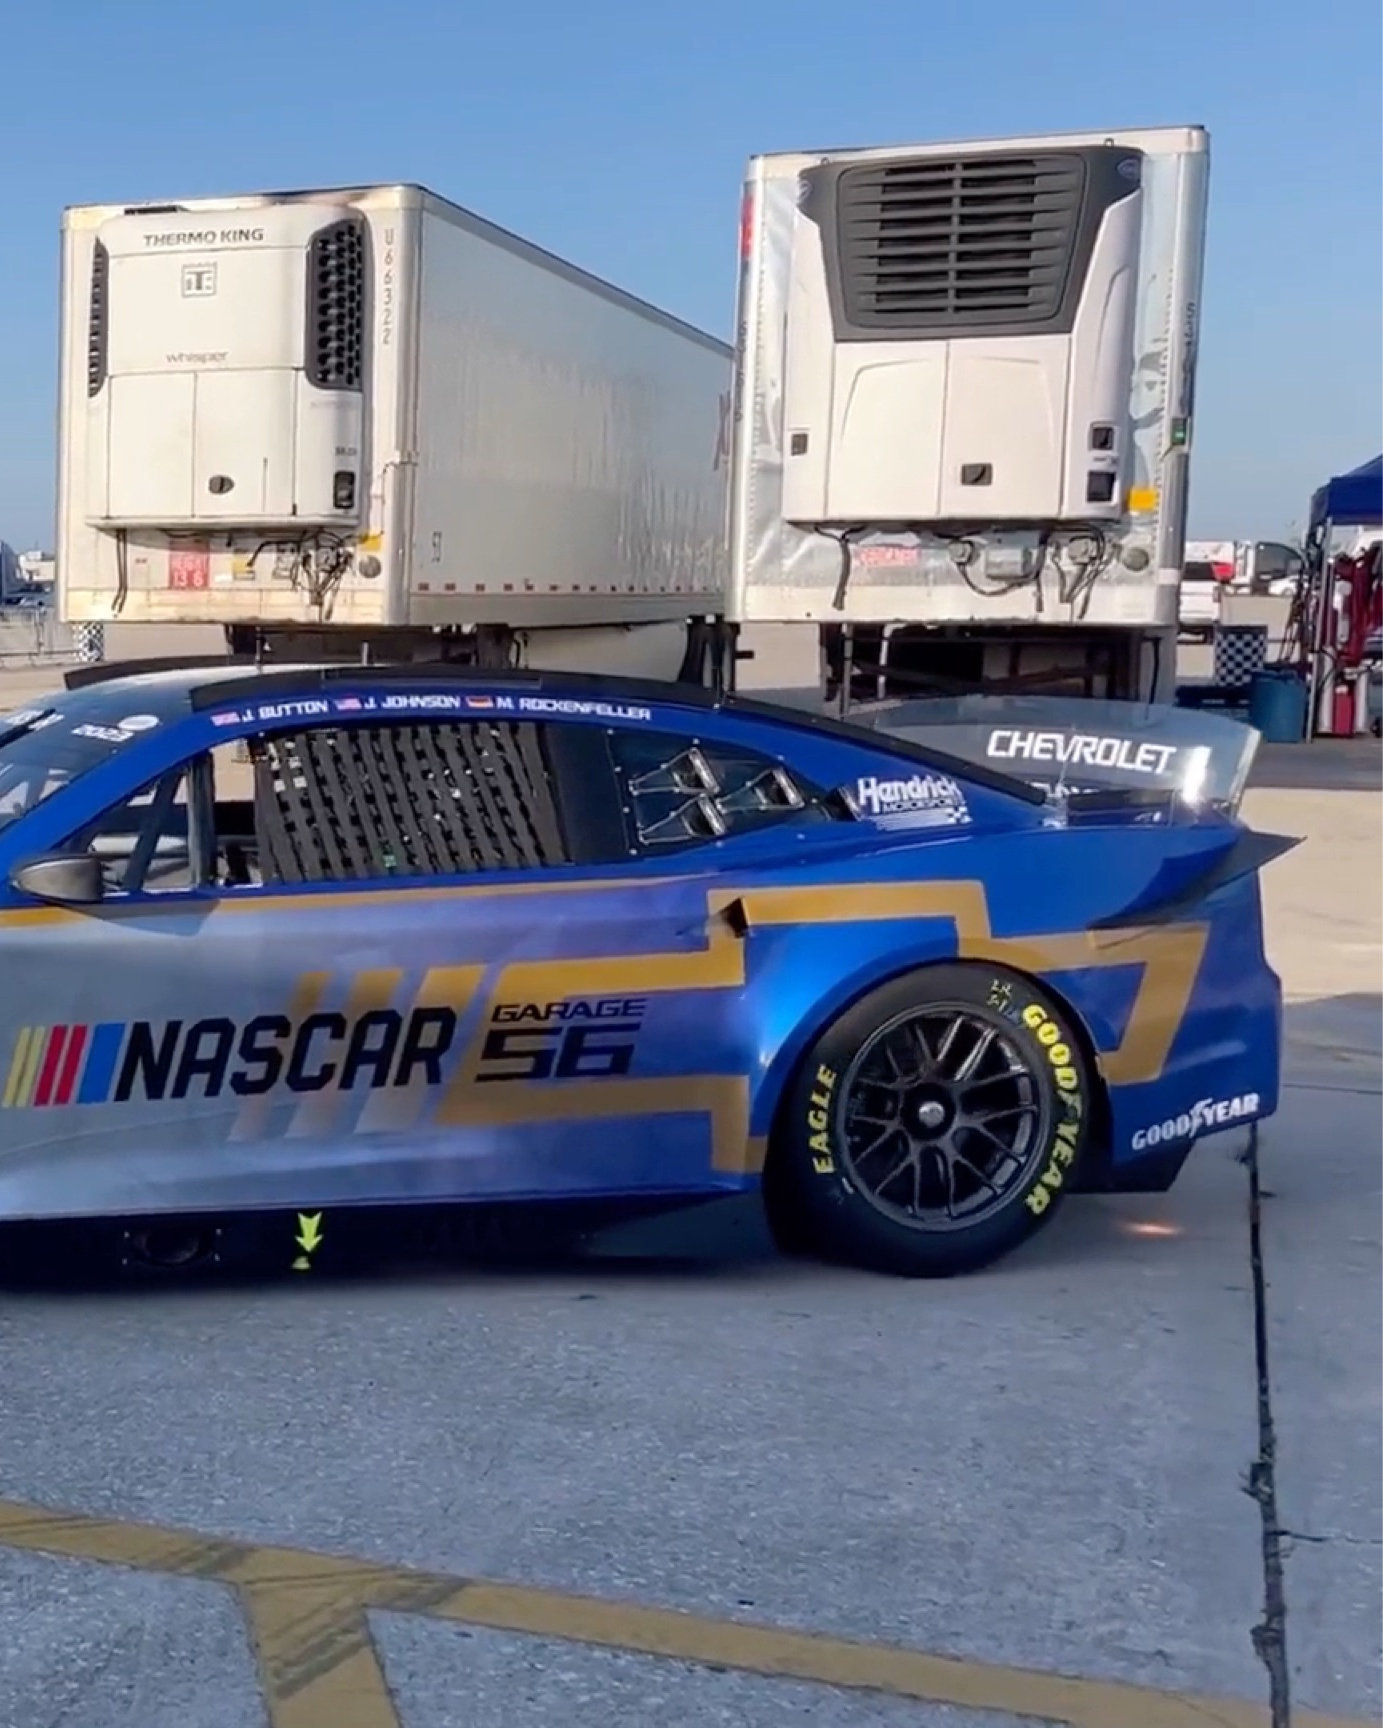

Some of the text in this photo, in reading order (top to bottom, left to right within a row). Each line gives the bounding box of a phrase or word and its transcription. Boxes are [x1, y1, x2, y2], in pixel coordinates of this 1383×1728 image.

[143, 228, 265, 247] THERMO KING
[259, 700, 329, 720] BUTTON
[382, 695, 461, 709] JOHNSON
[519, 697, 651, 721] ROCKENFELLER
[986, 730, 1177, 774] CHEVROLET
[857, 775, 966, 813] Hendrick
[491, 998, 647, 1022] GARAGE
[113, 1007, 457, 1102] NASCAR
[474, 1022, 642, 1083] 56
[808, 1063, 837, 1174] EAGLE
[1022, 1004, 1082, 1215] GOODYEAR
[1132, 1092, 1260, 1150] GOODYEAR
